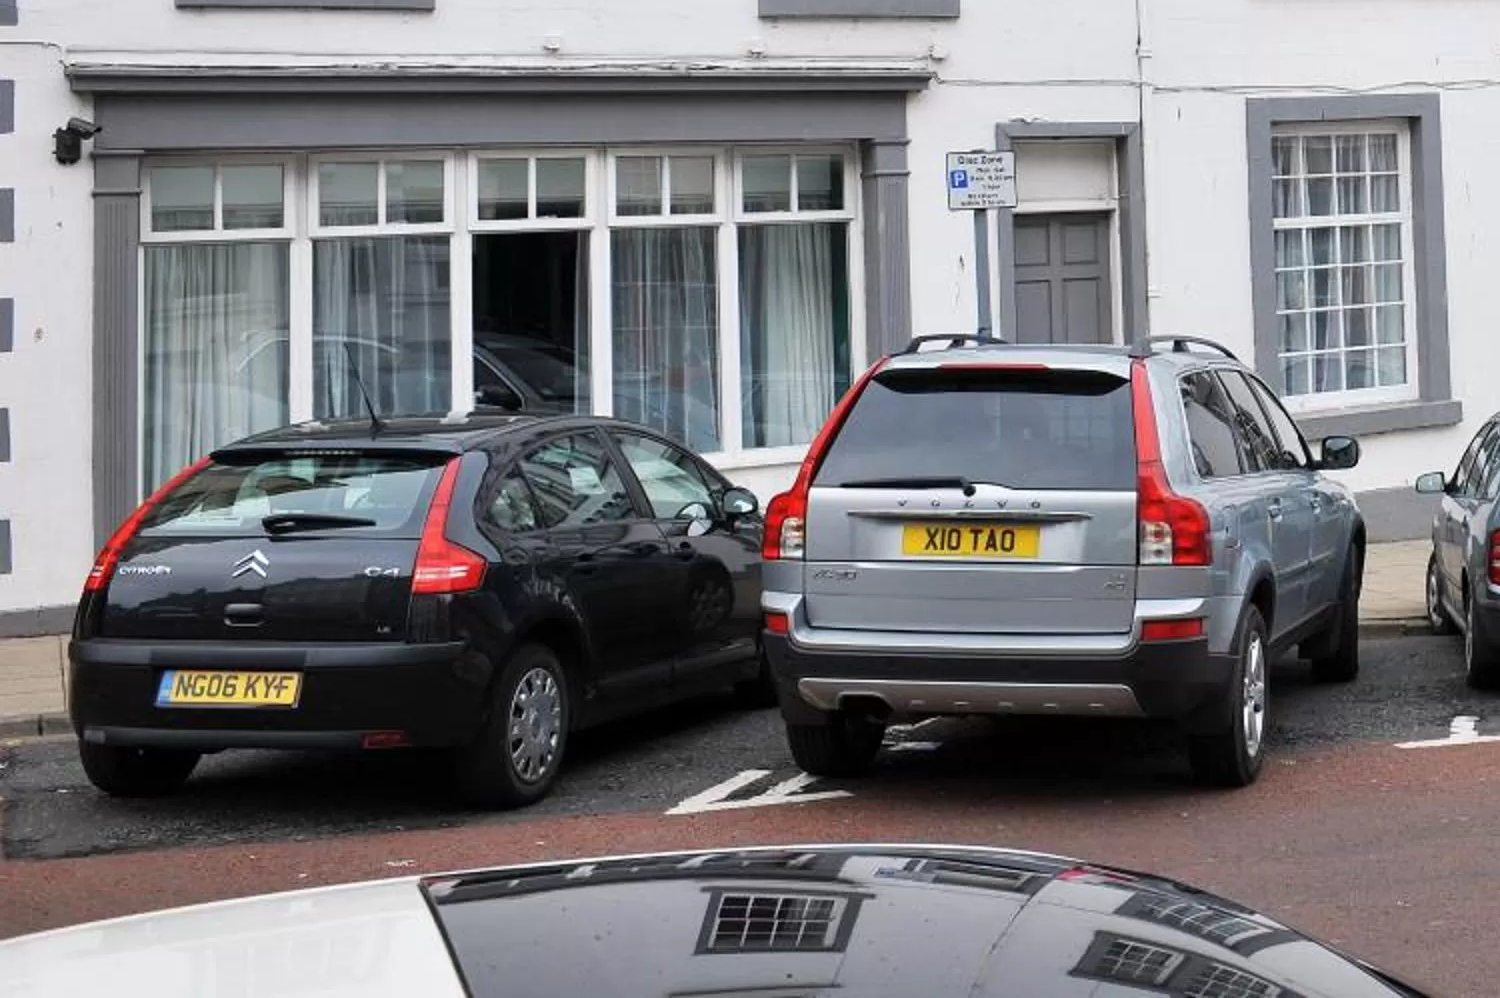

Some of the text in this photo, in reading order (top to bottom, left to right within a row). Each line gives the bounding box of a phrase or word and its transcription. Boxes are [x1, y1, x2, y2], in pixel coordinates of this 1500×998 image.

[897, 500, 1041, 509] VOLVO
[924, 527, 1015, 552] X10 TAO
[175, 674, 295, 699] NG06 KYF
